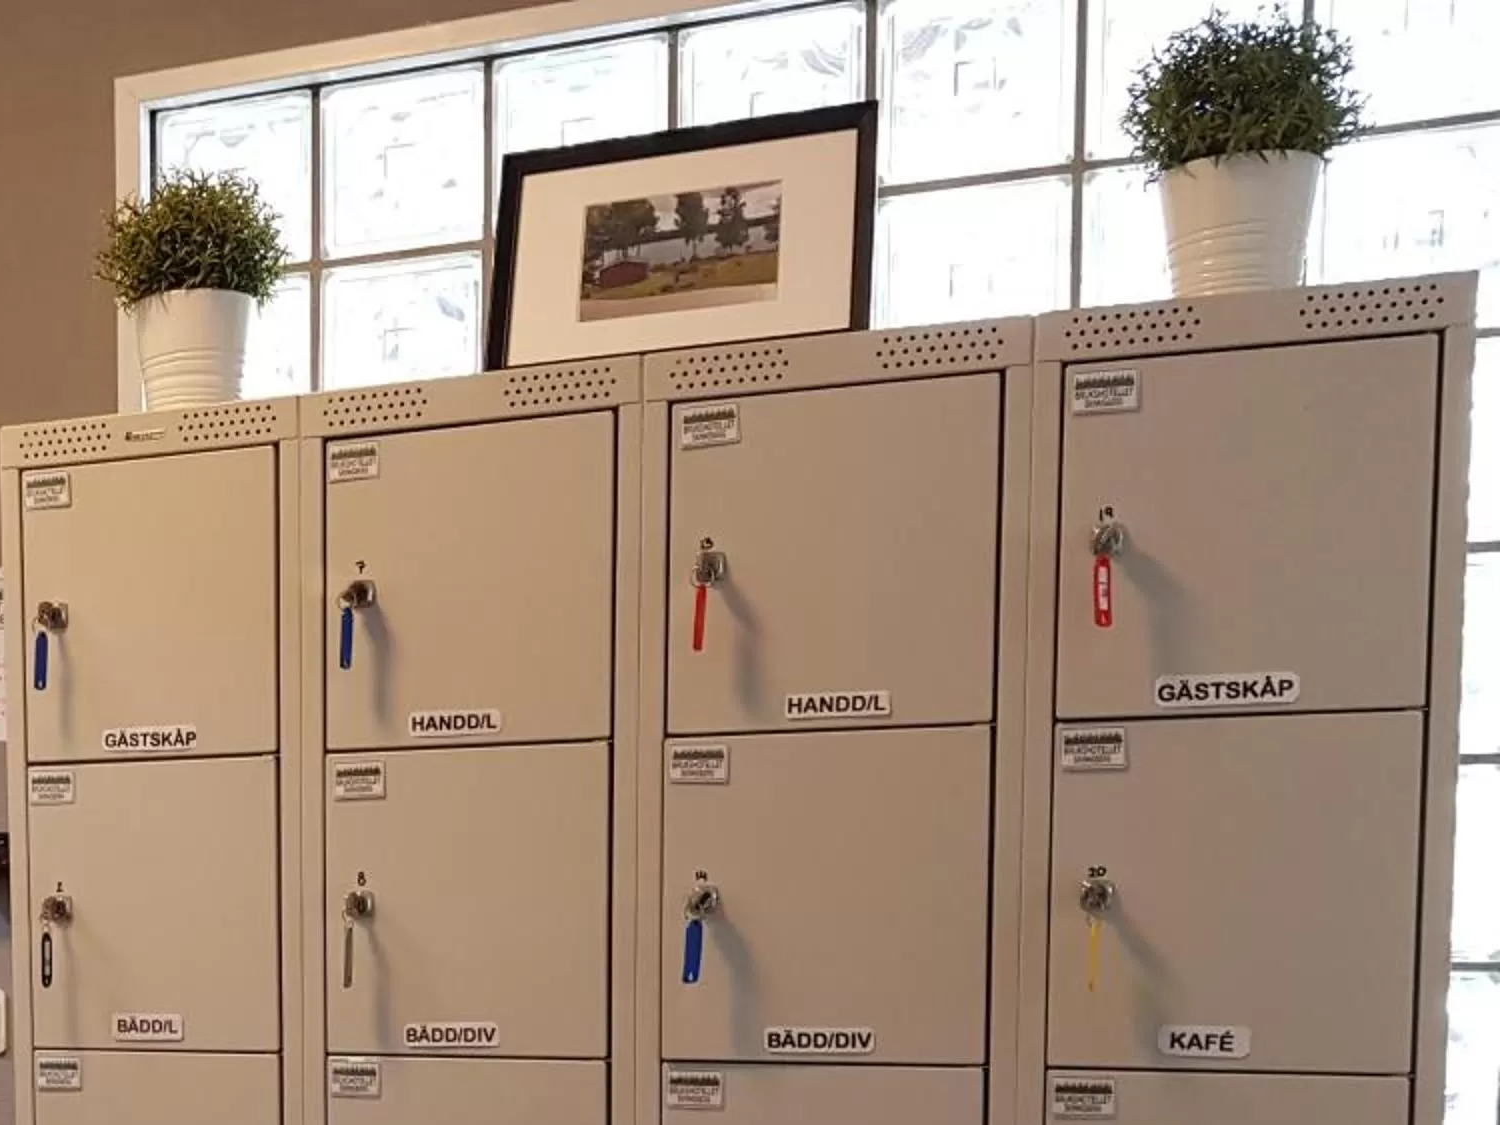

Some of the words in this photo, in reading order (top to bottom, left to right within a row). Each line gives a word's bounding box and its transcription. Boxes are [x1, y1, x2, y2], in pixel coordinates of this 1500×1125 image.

[1158, 676, 1294, 702] GÄSTSKÅP
[787, 694, 886, 715] HANDD/L
[412, 714, 497, 731] HANDD/L
[105, 729, 196, 748] GÄSTSKÅP
[357, 871, 367, 886] 8
[117, 1017, 178, 1034] BÄDD/L
[406, 1026, 496, 1043] BÄDD/DIV
[767, 1030, 871, 1049] BÄDD/DIV
[1169, 1031, 1235, 1052] KAFÉ
